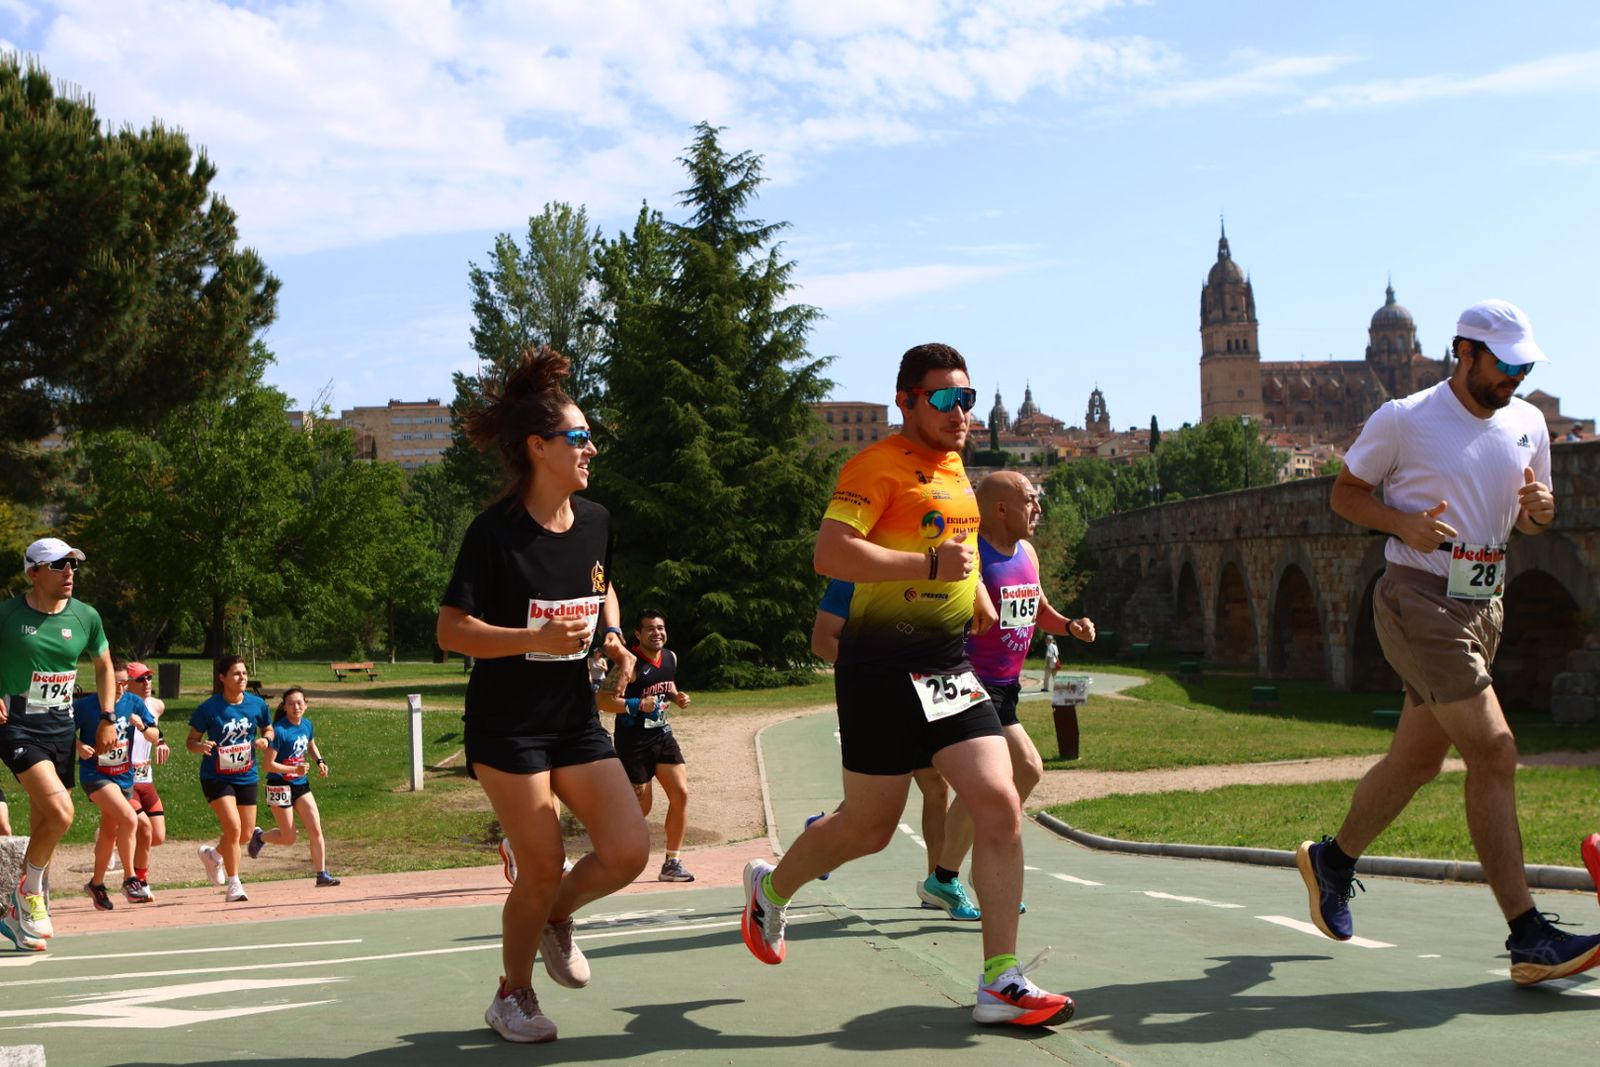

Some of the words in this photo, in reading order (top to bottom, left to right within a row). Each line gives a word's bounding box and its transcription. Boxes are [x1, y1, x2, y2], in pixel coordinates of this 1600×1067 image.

[1470, 564, 1496, 586] 28
[530, 602, 598, 619] bedunia
[1010, 598, 1036, 618] 165
[40, 683, 68, 699] 194
[109, 749, 123, 760] 39
[230, 753, 245, 763] 14
[270, 792, 287, 801] 230
